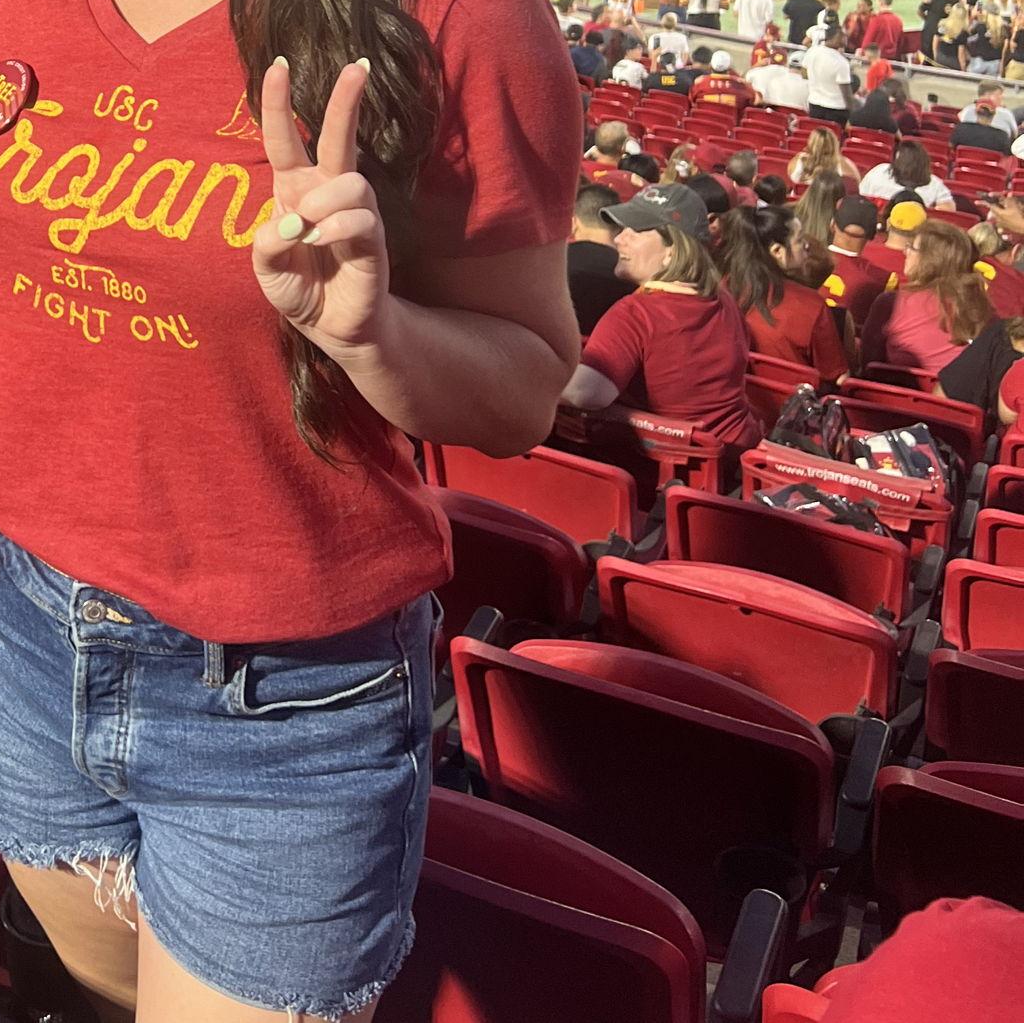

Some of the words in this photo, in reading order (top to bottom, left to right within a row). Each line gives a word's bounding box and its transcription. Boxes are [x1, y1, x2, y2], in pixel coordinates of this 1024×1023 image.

[93, 84, 159, 131] USC
[51, 258, 114, 291] EST.
[102, 275, 148, 305] 1880
[12, 273, 112, 344] FIGHT
[129, 314, 199, 350] ON!
[774, 463, 911, 503] www.trojanseats.com
